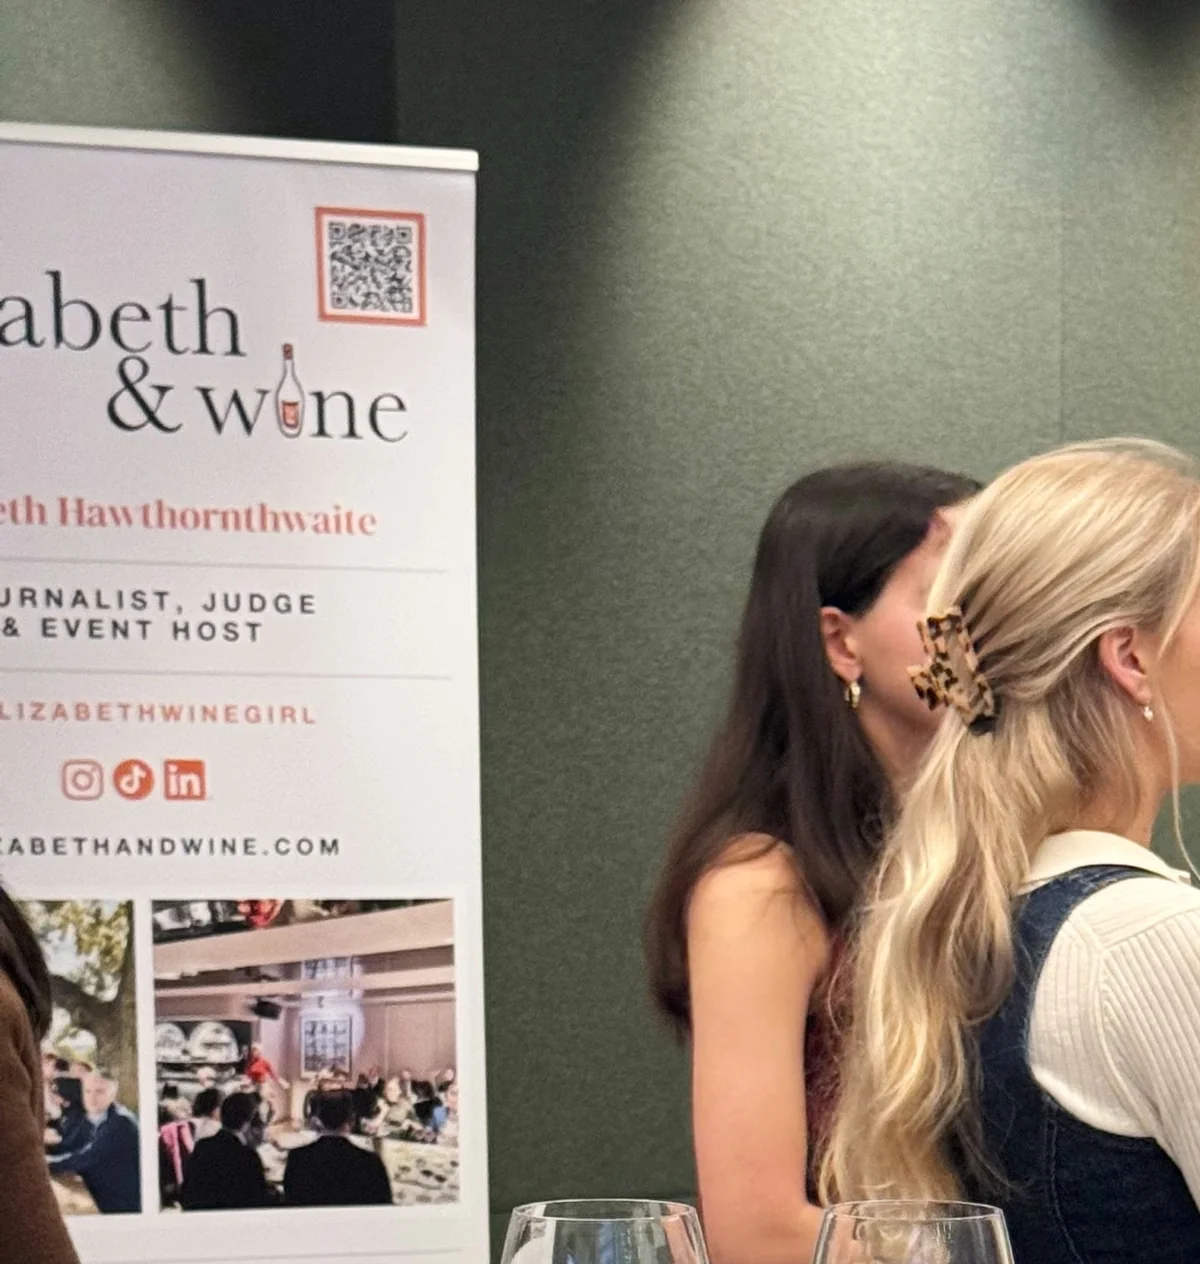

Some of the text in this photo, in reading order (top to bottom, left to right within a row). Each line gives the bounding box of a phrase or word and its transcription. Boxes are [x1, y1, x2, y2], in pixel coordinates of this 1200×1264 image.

[107, 355, 183, 433] &
[58, 496, 379, 537] Hawthornthwaite
[202, 592, 316, 615] JUDGE
[2, 616, 262, 642] & EVENT HOST
[0, 836, 340, 857] ABETHANDWINE.COM
